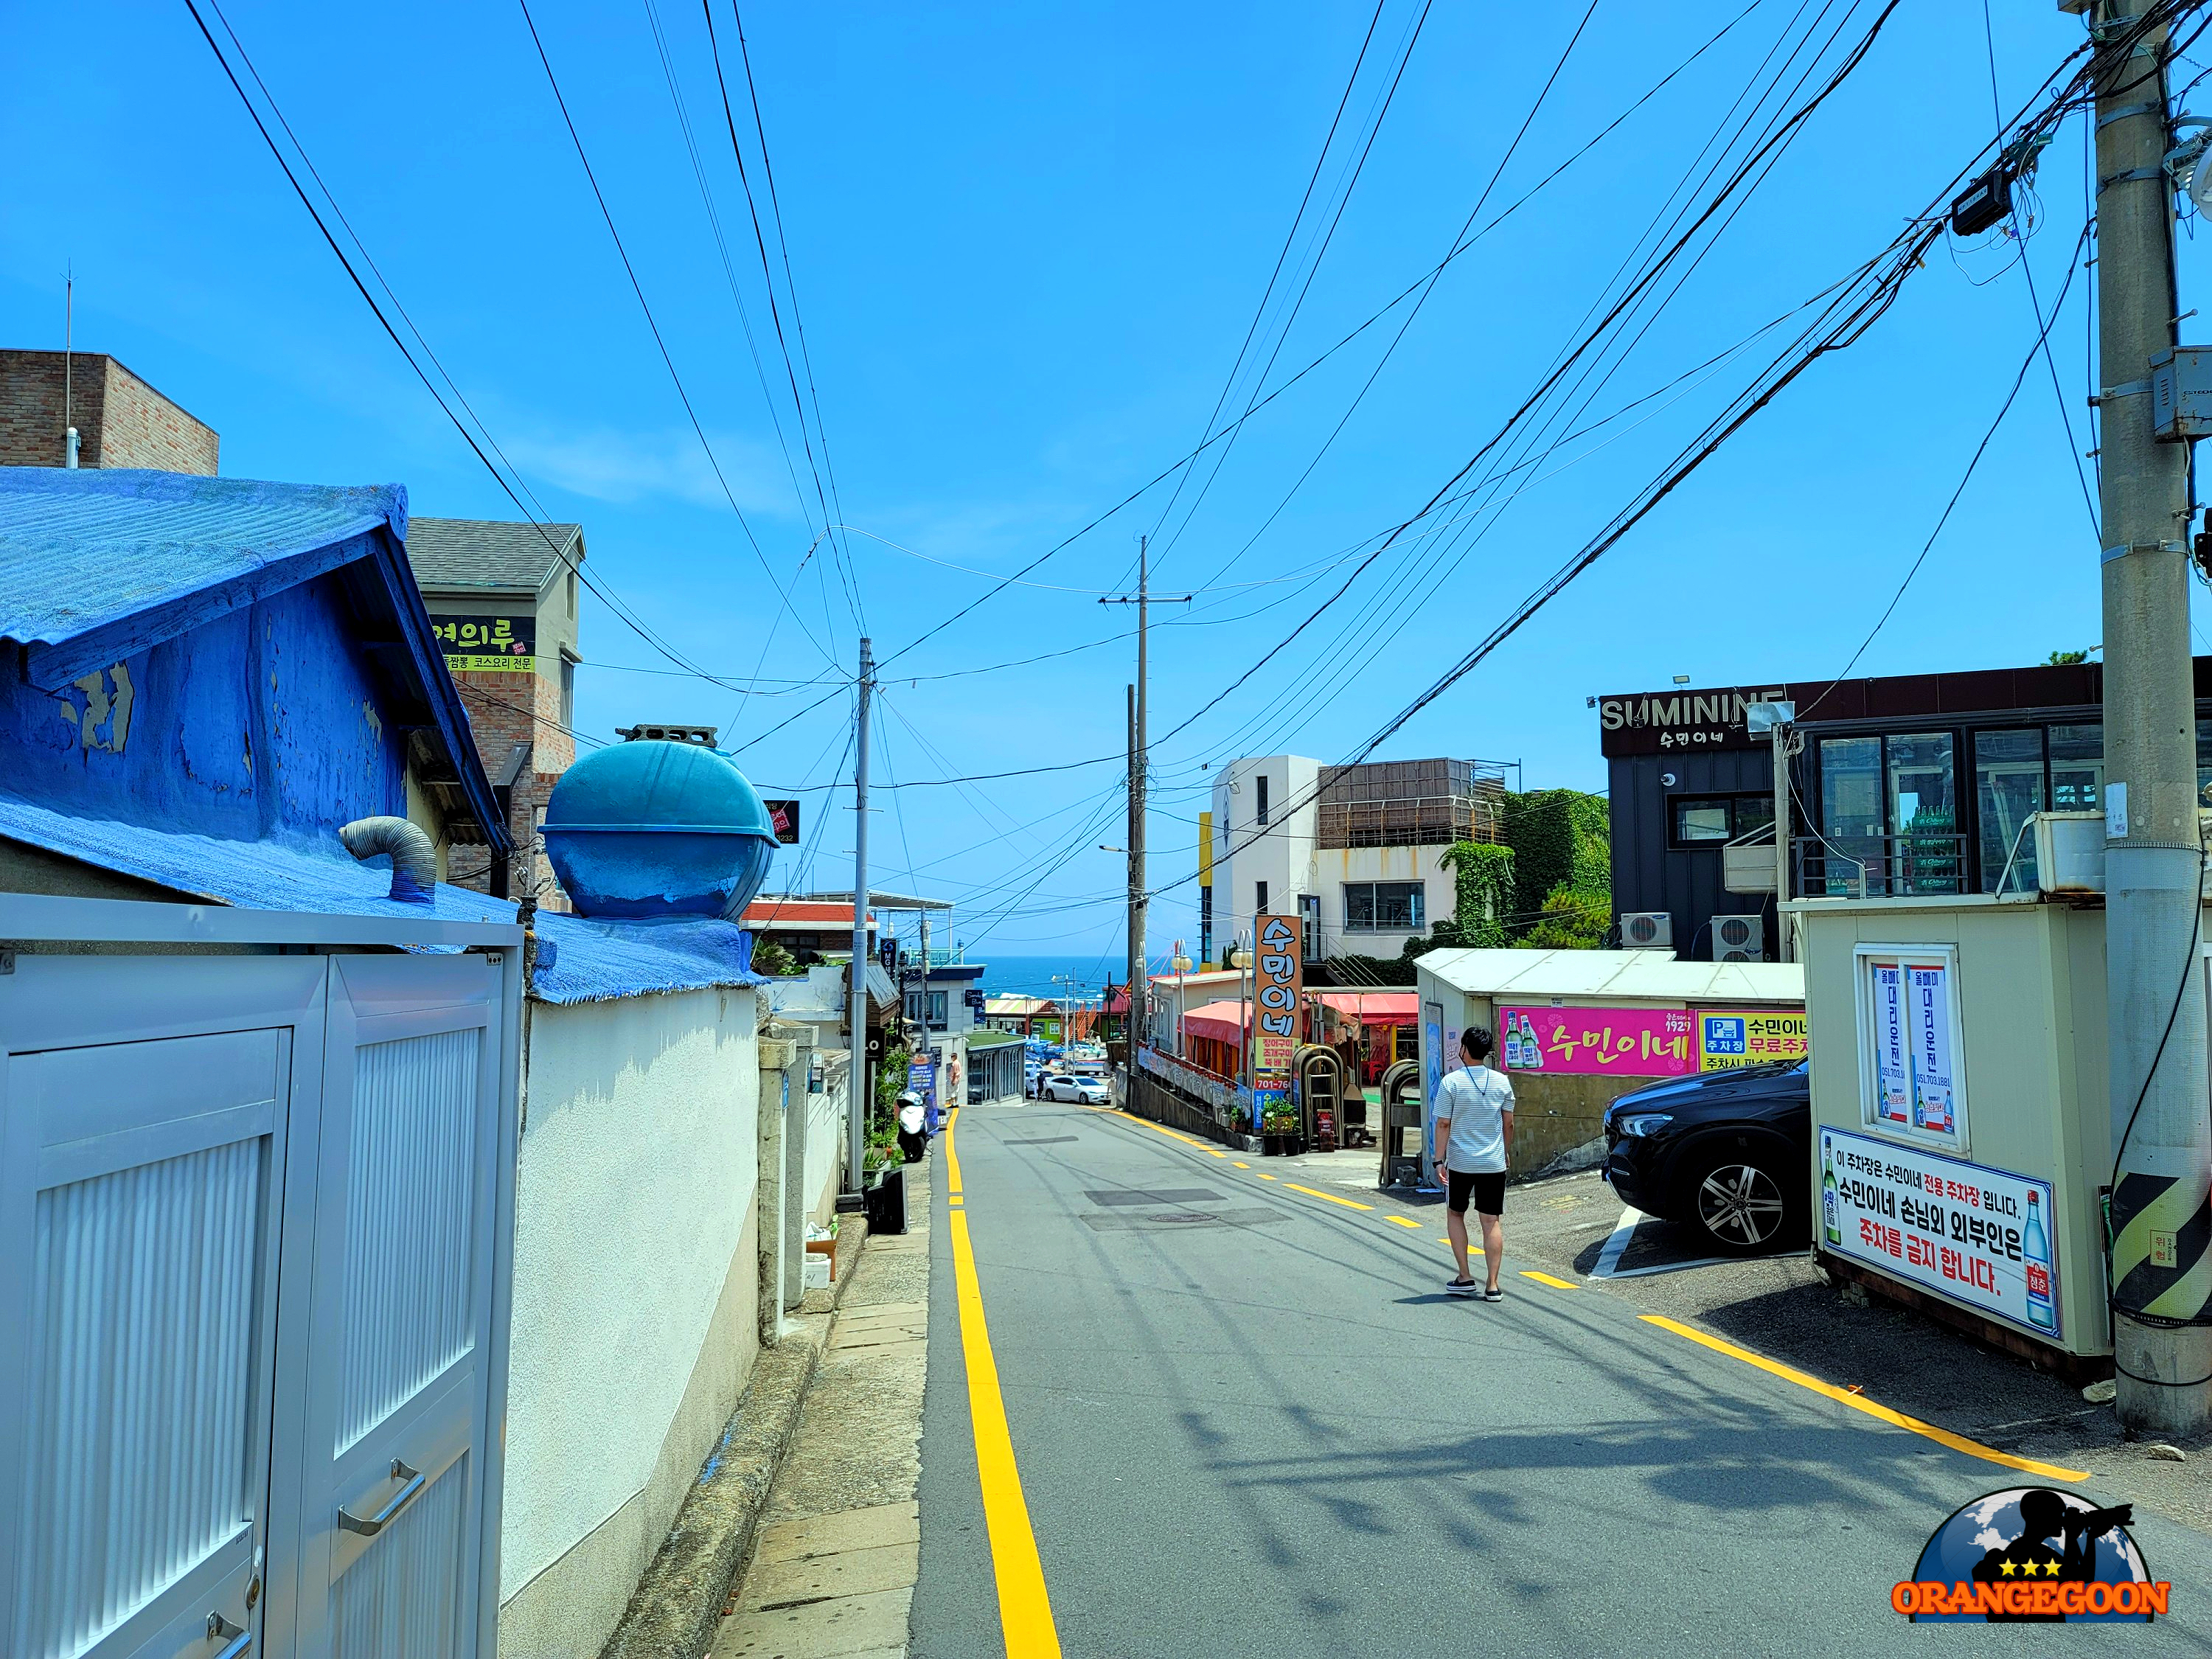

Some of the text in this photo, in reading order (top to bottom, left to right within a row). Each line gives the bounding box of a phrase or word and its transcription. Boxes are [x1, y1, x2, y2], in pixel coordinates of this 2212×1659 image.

[473, 658, 509, 669] 코스요리
[513, 658, 532, 669] 전문
[1660, 731, 1723, 748] 수민이네
[1260, 918, 1295, 1037] 수민이네
[1916, 971, 1938, 987] 올빼미
[1665, 1020, 1691, 1032] 1929
[1714, 1021, 1724, 1034] P
[1888, 986, 1900, 1066] 대리운전
[1922, 988, 1937, 1073] 대리운전
[1262, 1039, 1293, 1047] 장어구이
[1546, 1024, 1689, 1064] 수민이네
[1707, 1040, 1744, 1051] 주차장
[1263, 1048, 1293, 1057] 조개구이
[1917, 1074, 1950, 1088] 051.703.1881
[1837, 1150, 2021, 1220] 이 주차장은 수민이네 전용 주차장 입니다.
[1839, 1177, 2023, 1262] 수민이네 손님외 외부인은
[1860, 1217, 2001, 1297] 주차를 금지 합니다.
[2029, 1274, 2047, 1293] 청춘
